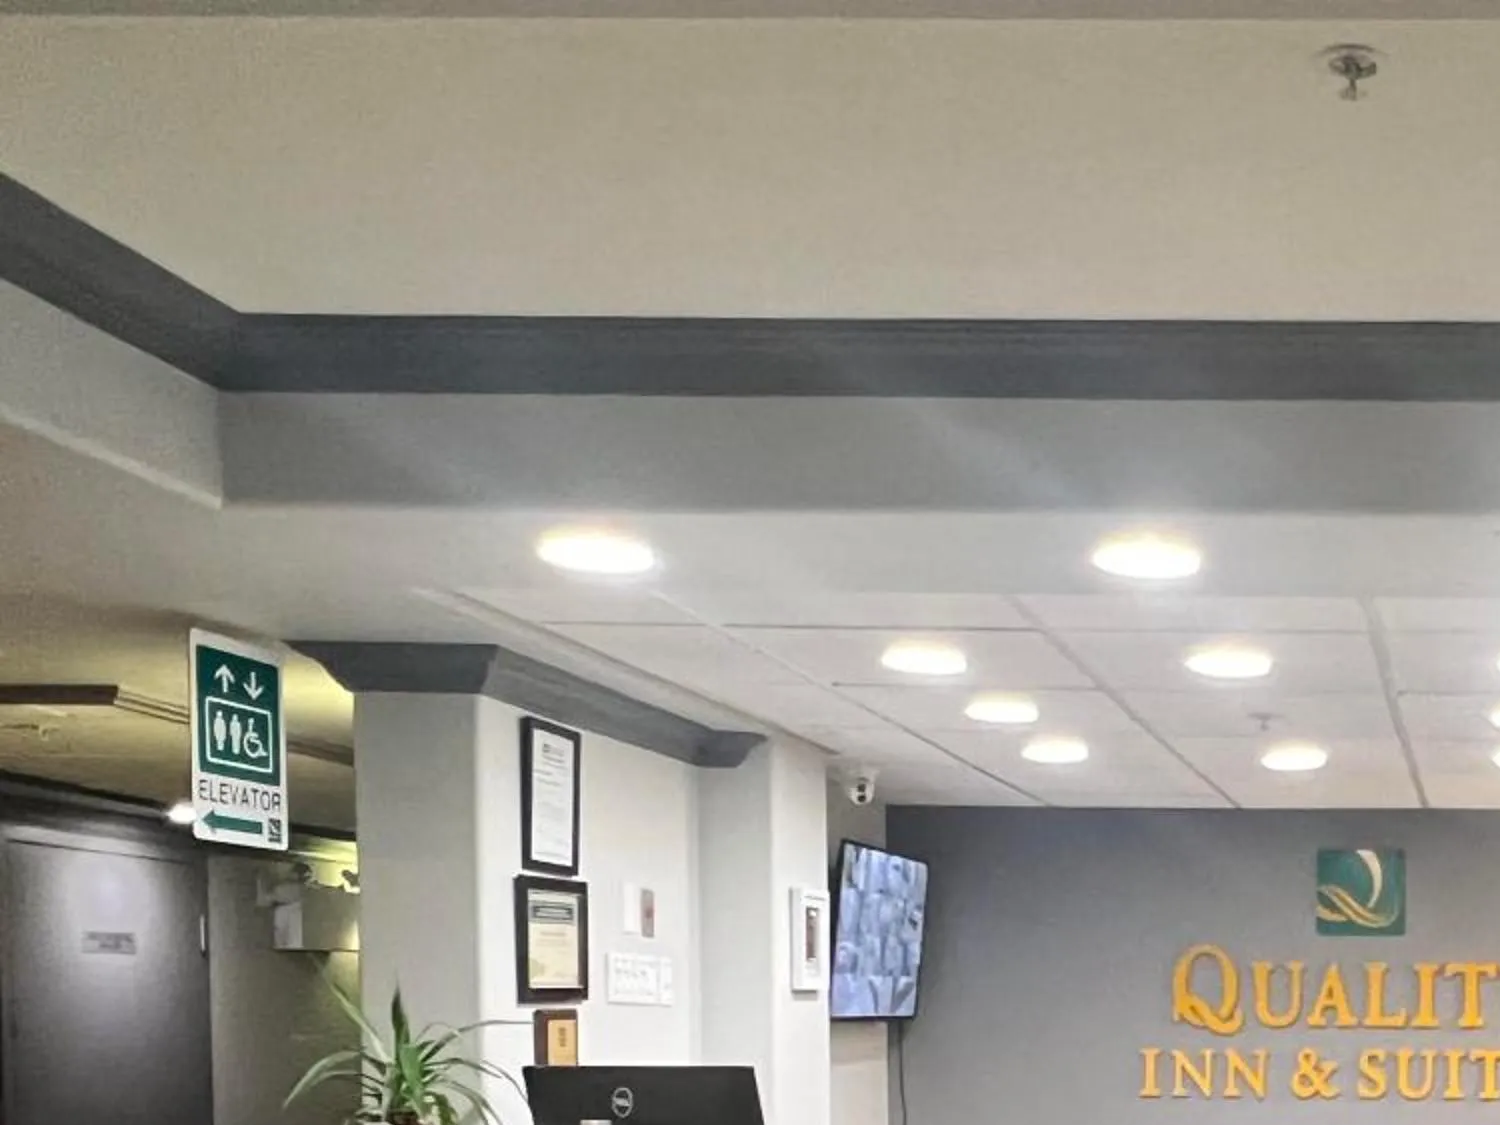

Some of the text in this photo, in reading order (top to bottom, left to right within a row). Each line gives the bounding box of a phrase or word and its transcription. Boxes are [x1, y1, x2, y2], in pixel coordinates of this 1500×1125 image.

[198, 778, 281, 811] ELEVATOR
[1138, 1047, 1270, 1099] INN
[1291, 1047, 1342, 1101] &
